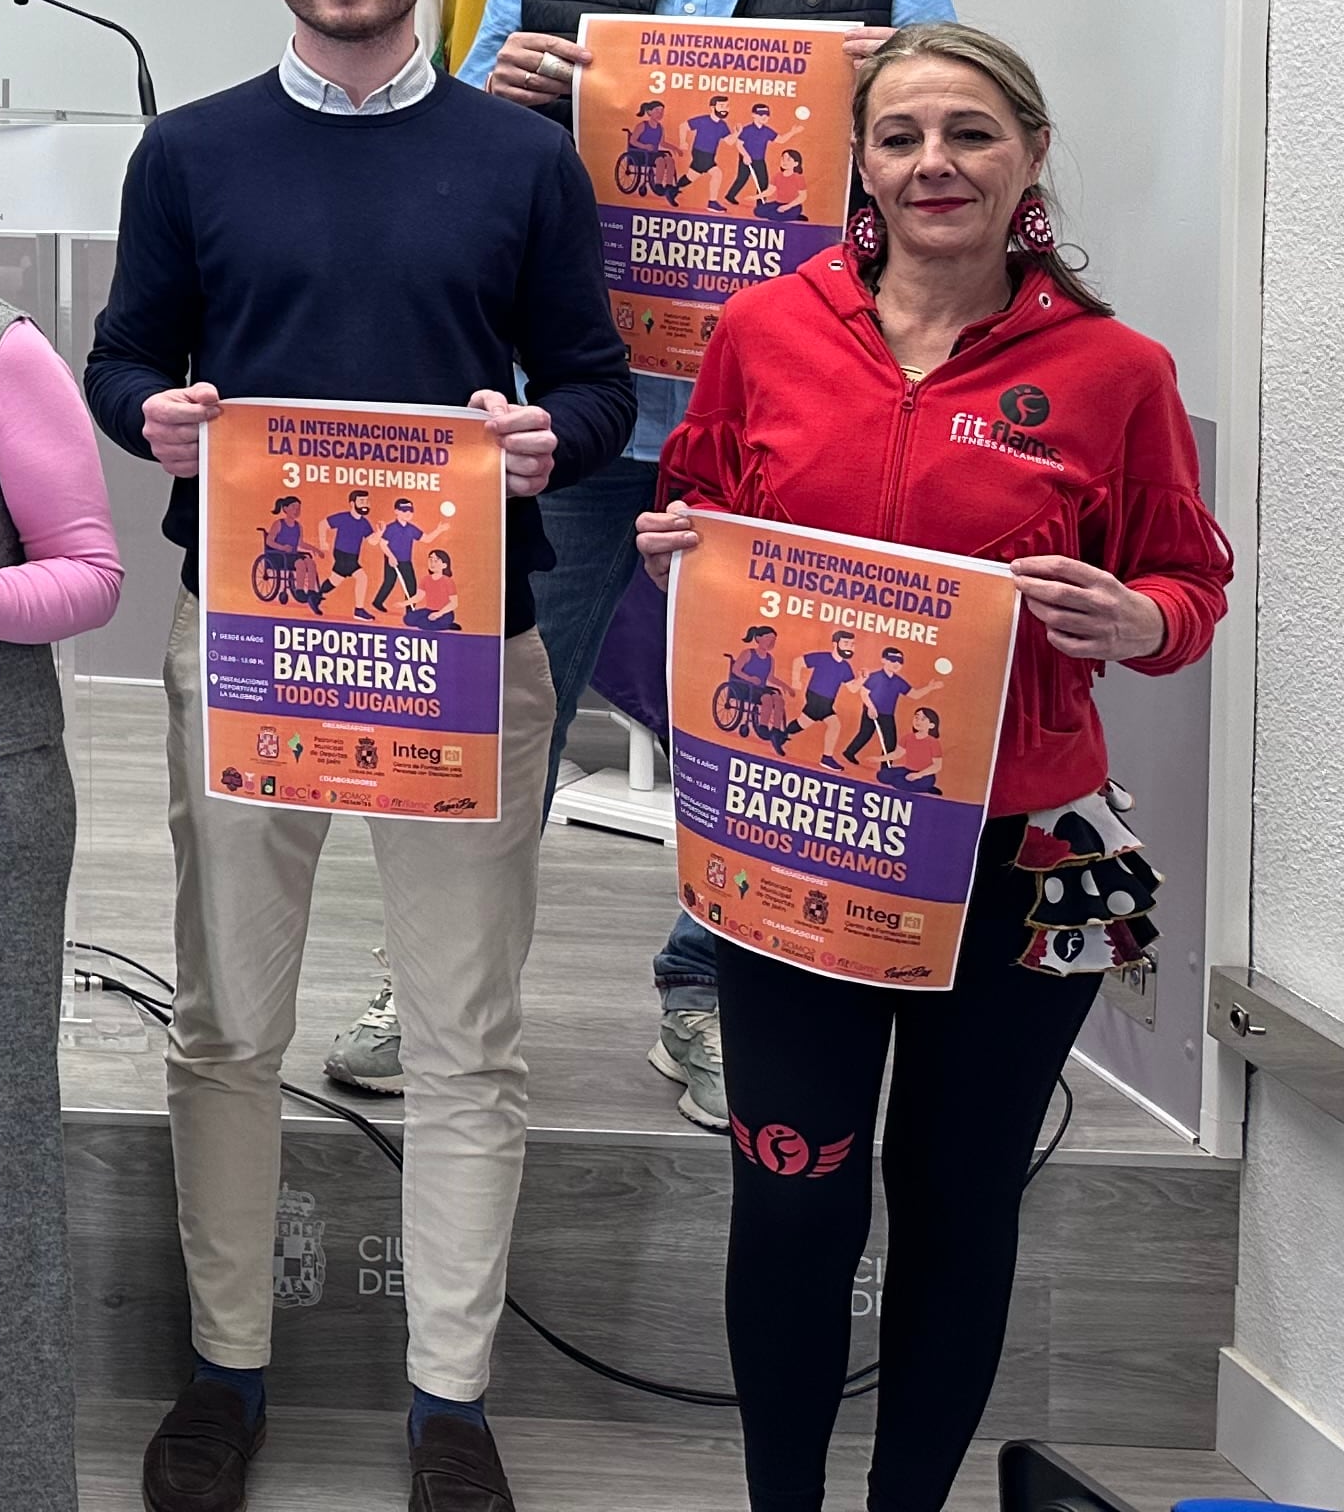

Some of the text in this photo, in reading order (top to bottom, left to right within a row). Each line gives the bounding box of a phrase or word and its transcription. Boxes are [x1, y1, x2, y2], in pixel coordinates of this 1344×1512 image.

[641, 29, 813, 55] DÍA INTERNACIONAL DE
[639, 48, 807, 75] LA DISCAPACIDAD
[648, 71, 797, 99] 3 DE DICIEMBRE
[631, 215, 786, 251] DEPORTE SIN
[630, 237, 781, 278] BARRERAS
[630, 266, 689, 289] TODOS
[268, 415, 454, 445] DÍA INTERNACIONAL DE
[951, 413, 987, 439] fit
[268, 436, 449, 466] LA DISCAPACIDAD
[949, 434, 1064, 471] FITNESS & FLAMENCO
[282, 462, 441, 492] 3 DE DICIEMBRE
[752, 539, 961, 598] DÍA INTERNACIONAL DE
[748, 559, 953, 620] LA DISCAPACIDAD
[759, 590, 939, 646] 3 DE DICIEMBRE
[274, 626, 438, 664] DEPORTE SIN
[274, 652, 437, 694] BARRERAS
[274, 684, 441, 718] TODOS JUGAMOS
[729, 757, 913, 827] DEPORTE SIN
[726, 784, 907, 858] BARRERAS
[725, 815, 908, 883] TODOS JUGAMOS
[359, 1268, 404, 1296] DE
